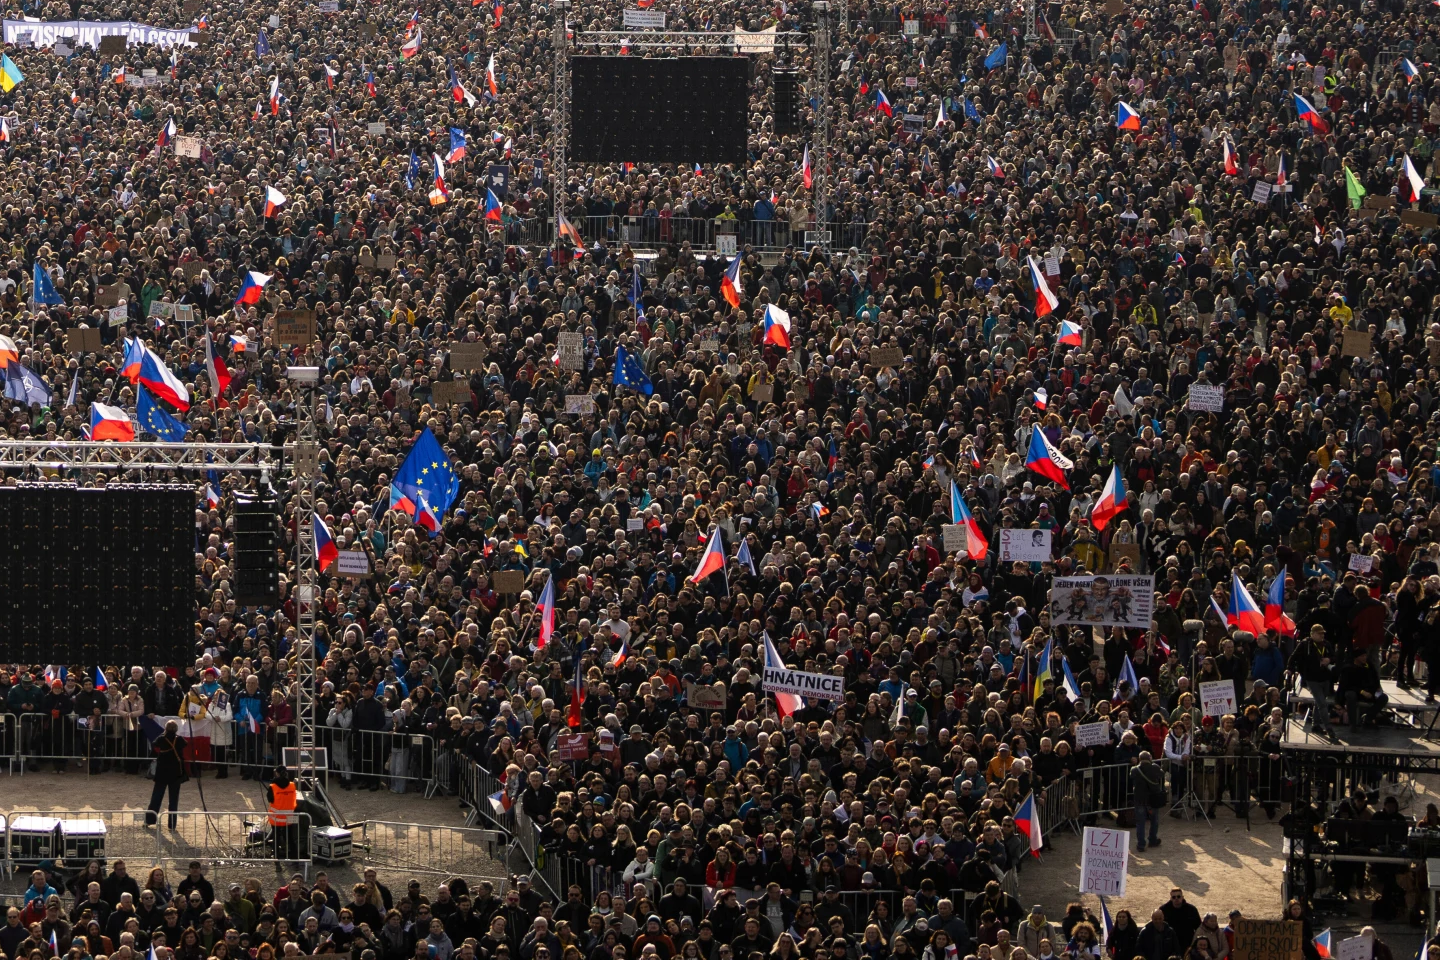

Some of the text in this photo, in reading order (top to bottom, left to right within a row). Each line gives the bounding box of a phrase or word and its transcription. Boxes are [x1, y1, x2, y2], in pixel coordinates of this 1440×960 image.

[534, 167, 541, 179] P3
[1133, 577, 1151, 587] VŠEM
[764, 669, 841, 692] HNÁTNICE
[763, 684, 800, 694] PODPORUJE
[803, 689, 843, 700] DEMOKRACII
[1209, 698, 1225, 706] STOP
[1091, 830, 1119, 849] LŽI
[1089, 869, 1118, 878] NEJSME
[1087, 877, 1120, 893] DĚTI!
[1236, 937, 1299, 953] UHERSKOU
